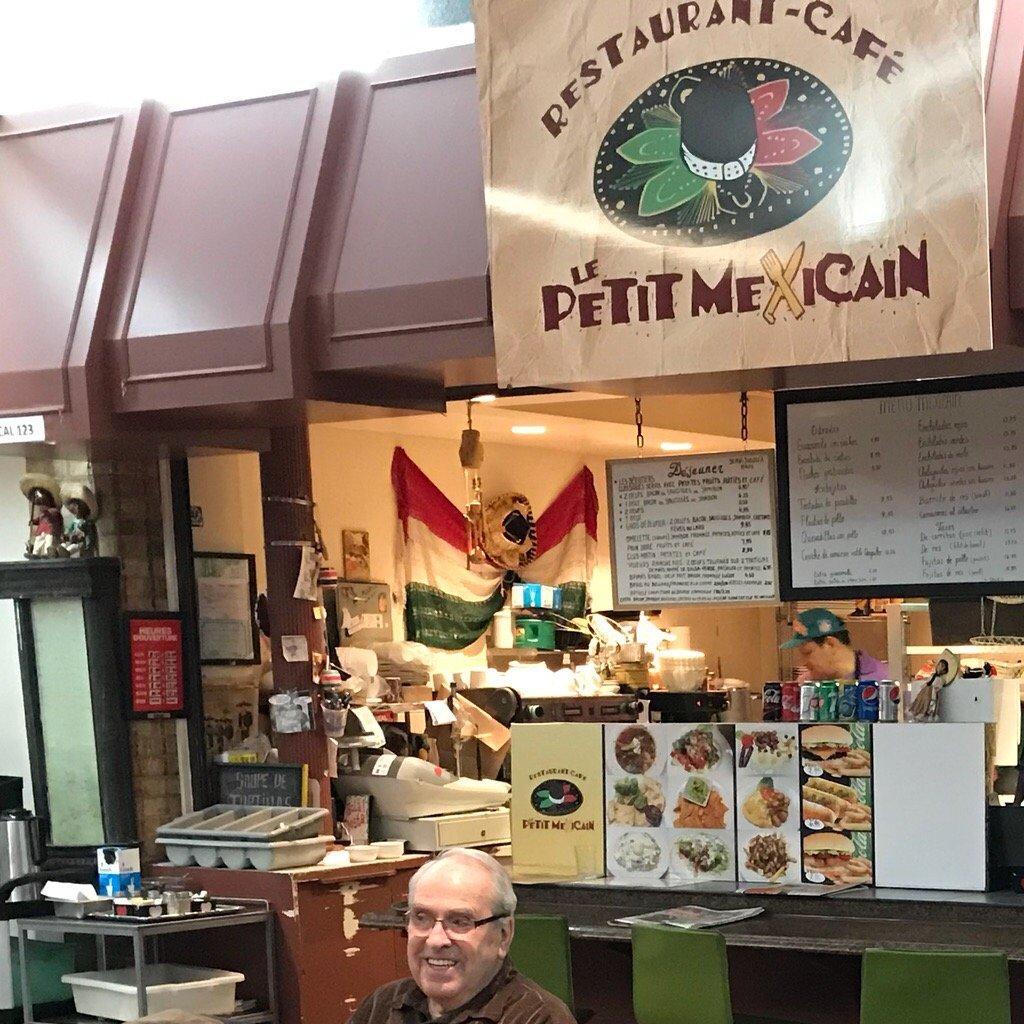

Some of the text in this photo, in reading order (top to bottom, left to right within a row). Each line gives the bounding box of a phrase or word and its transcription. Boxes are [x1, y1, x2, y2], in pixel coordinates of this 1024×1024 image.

[572, 259, 598, 284] LE
[541, 240, 930, 332] PETIT MEXICAIN
[17, 424, 33, 436] 123
[522, 819, 551, 830] PETIT
